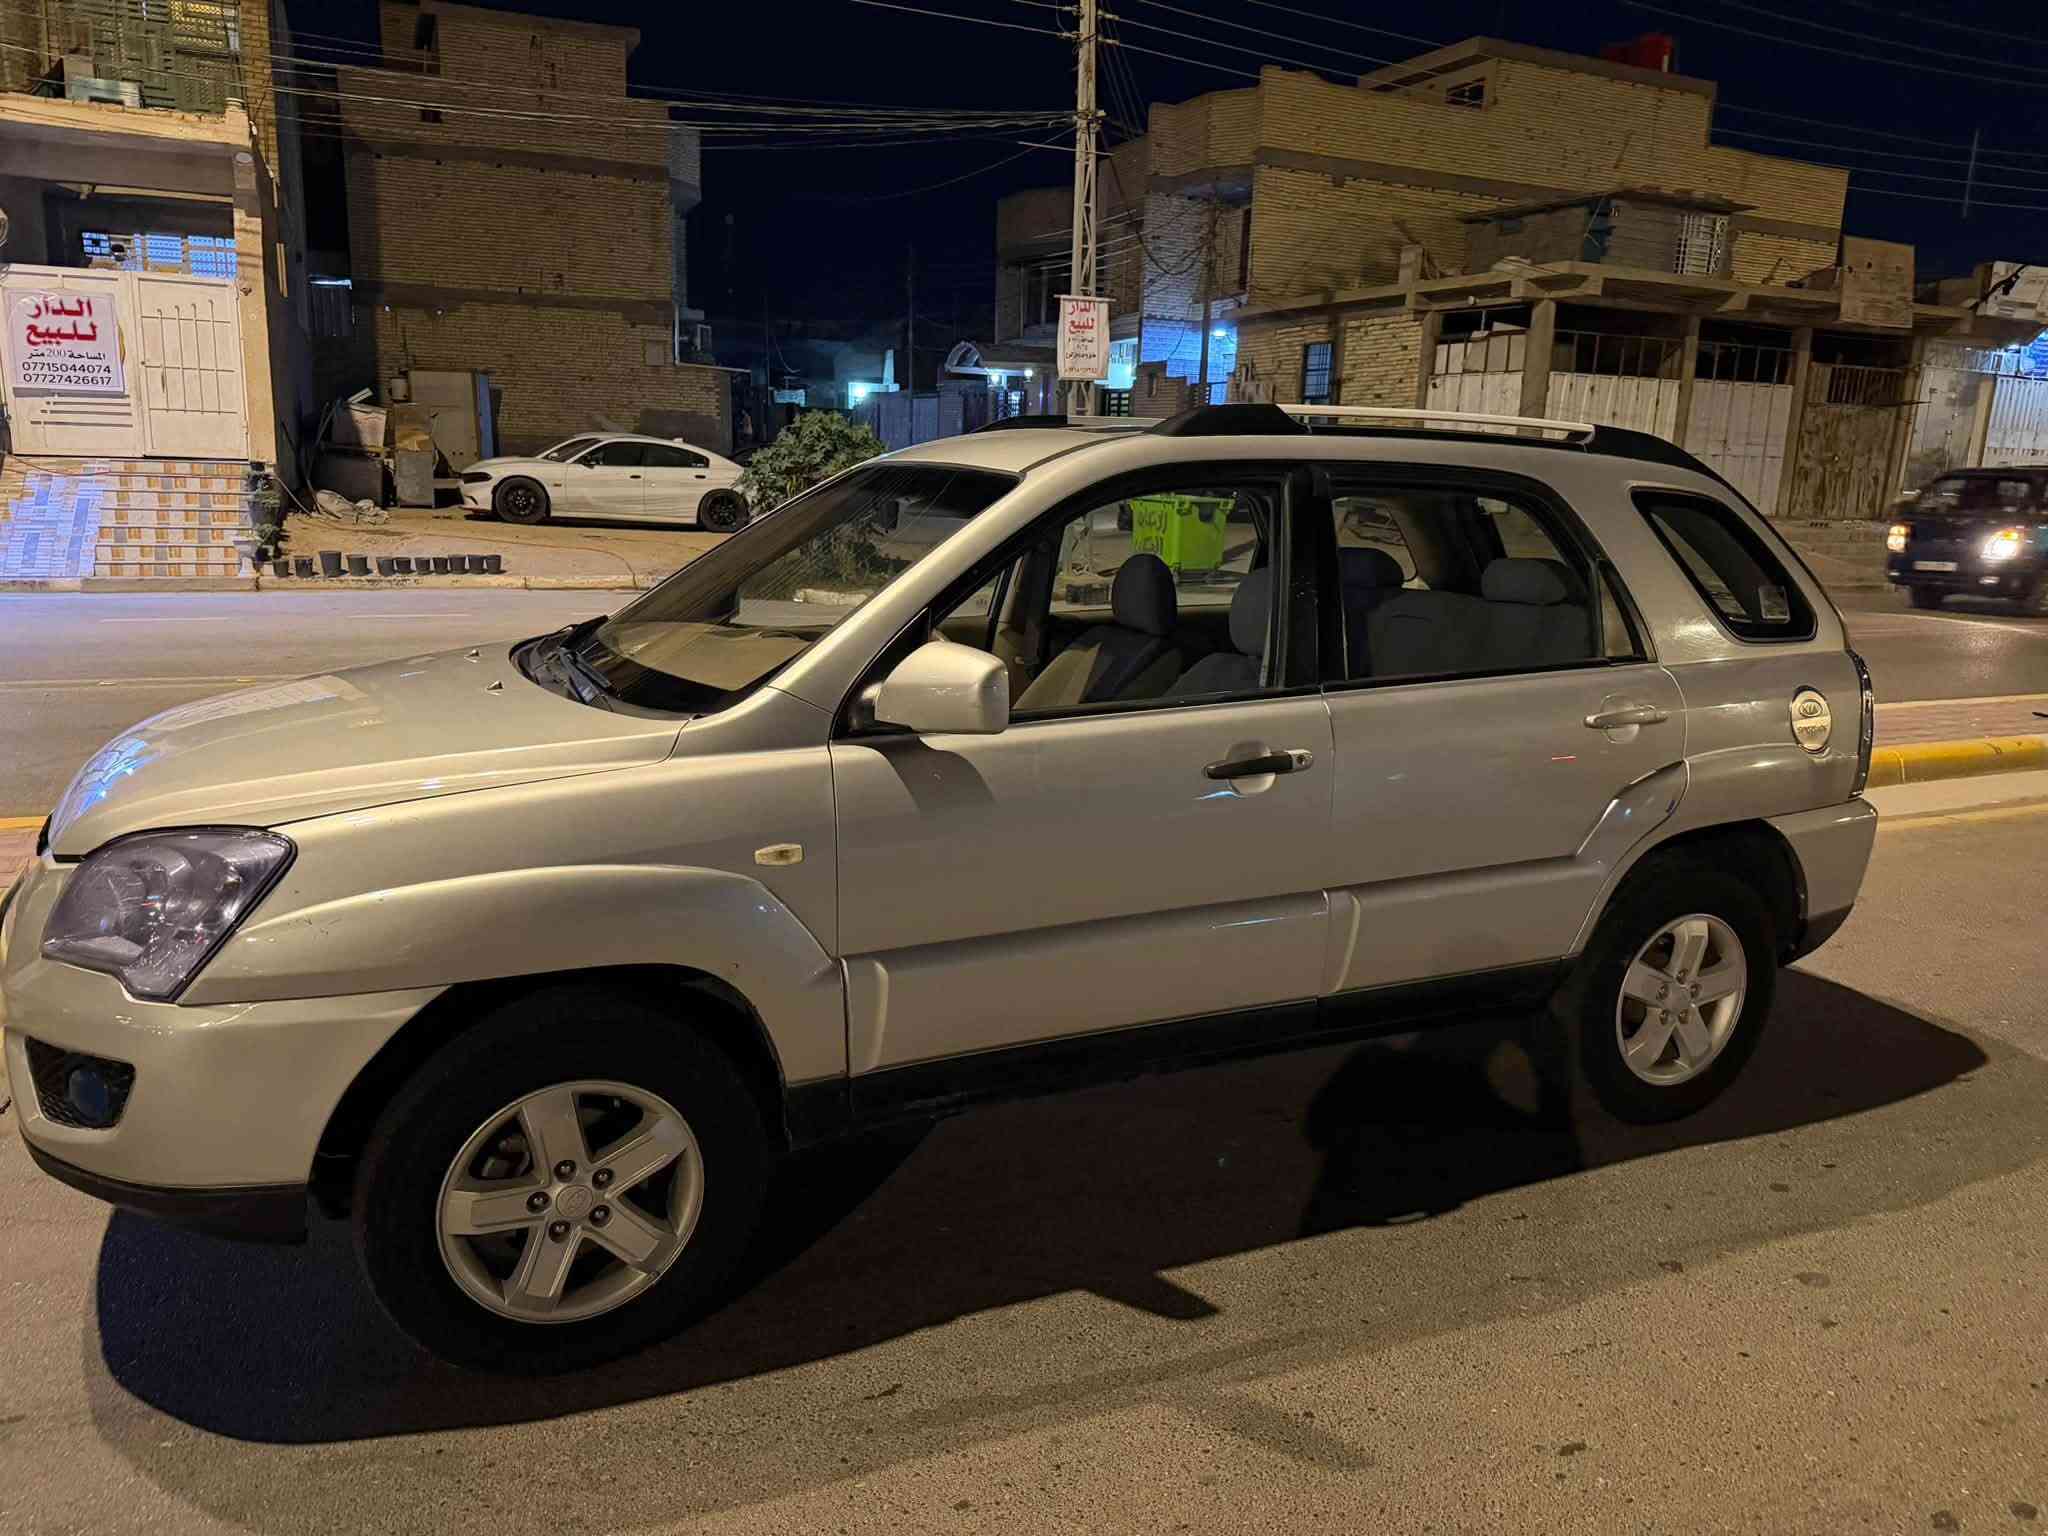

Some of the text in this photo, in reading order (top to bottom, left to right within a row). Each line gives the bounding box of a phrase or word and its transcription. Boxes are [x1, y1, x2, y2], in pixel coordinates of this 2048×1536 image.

[25, 297, 92, 319] الدار
[26, 320, 97, 346] للبيع
[1068, 318, 1095, 335] للبيع
[22, 361, 111, 374] 07715044074
[23, 374, 112, 386] 07727426617
[1800, 702, 1821, 714] KIA
